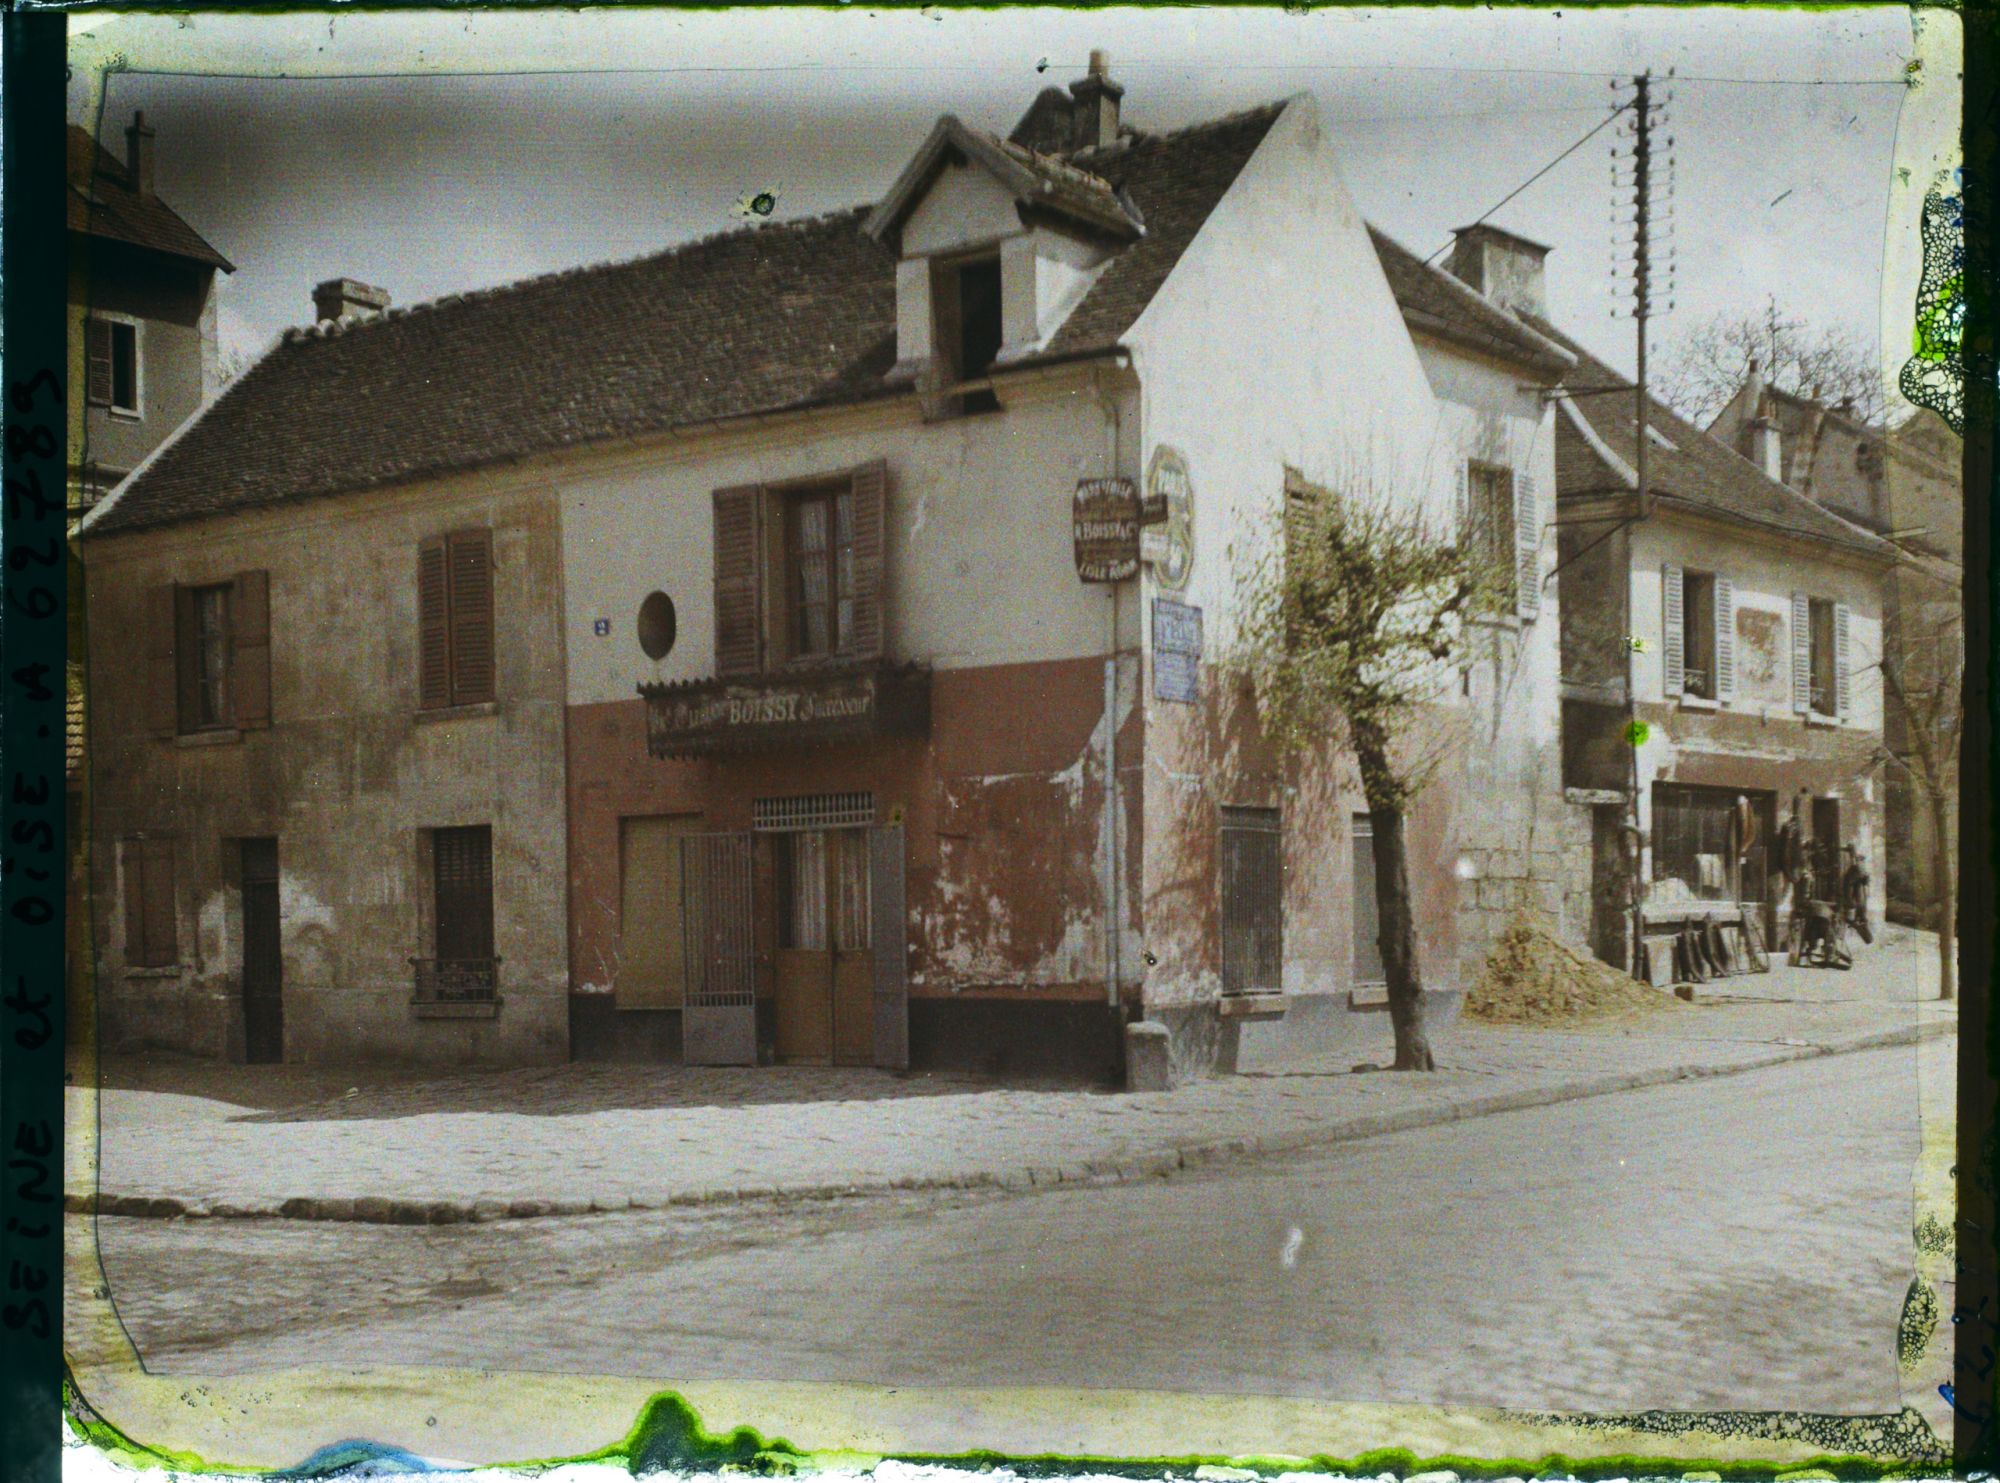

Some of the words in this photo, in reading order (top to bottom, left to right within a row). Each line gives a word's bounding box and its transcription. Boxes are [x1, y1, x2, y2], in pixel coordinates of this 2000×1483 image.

[6, 369, 60, 619] 62789
[728, 694, 800, 726] BOISSY
[4, 976, 54, 1052] et
